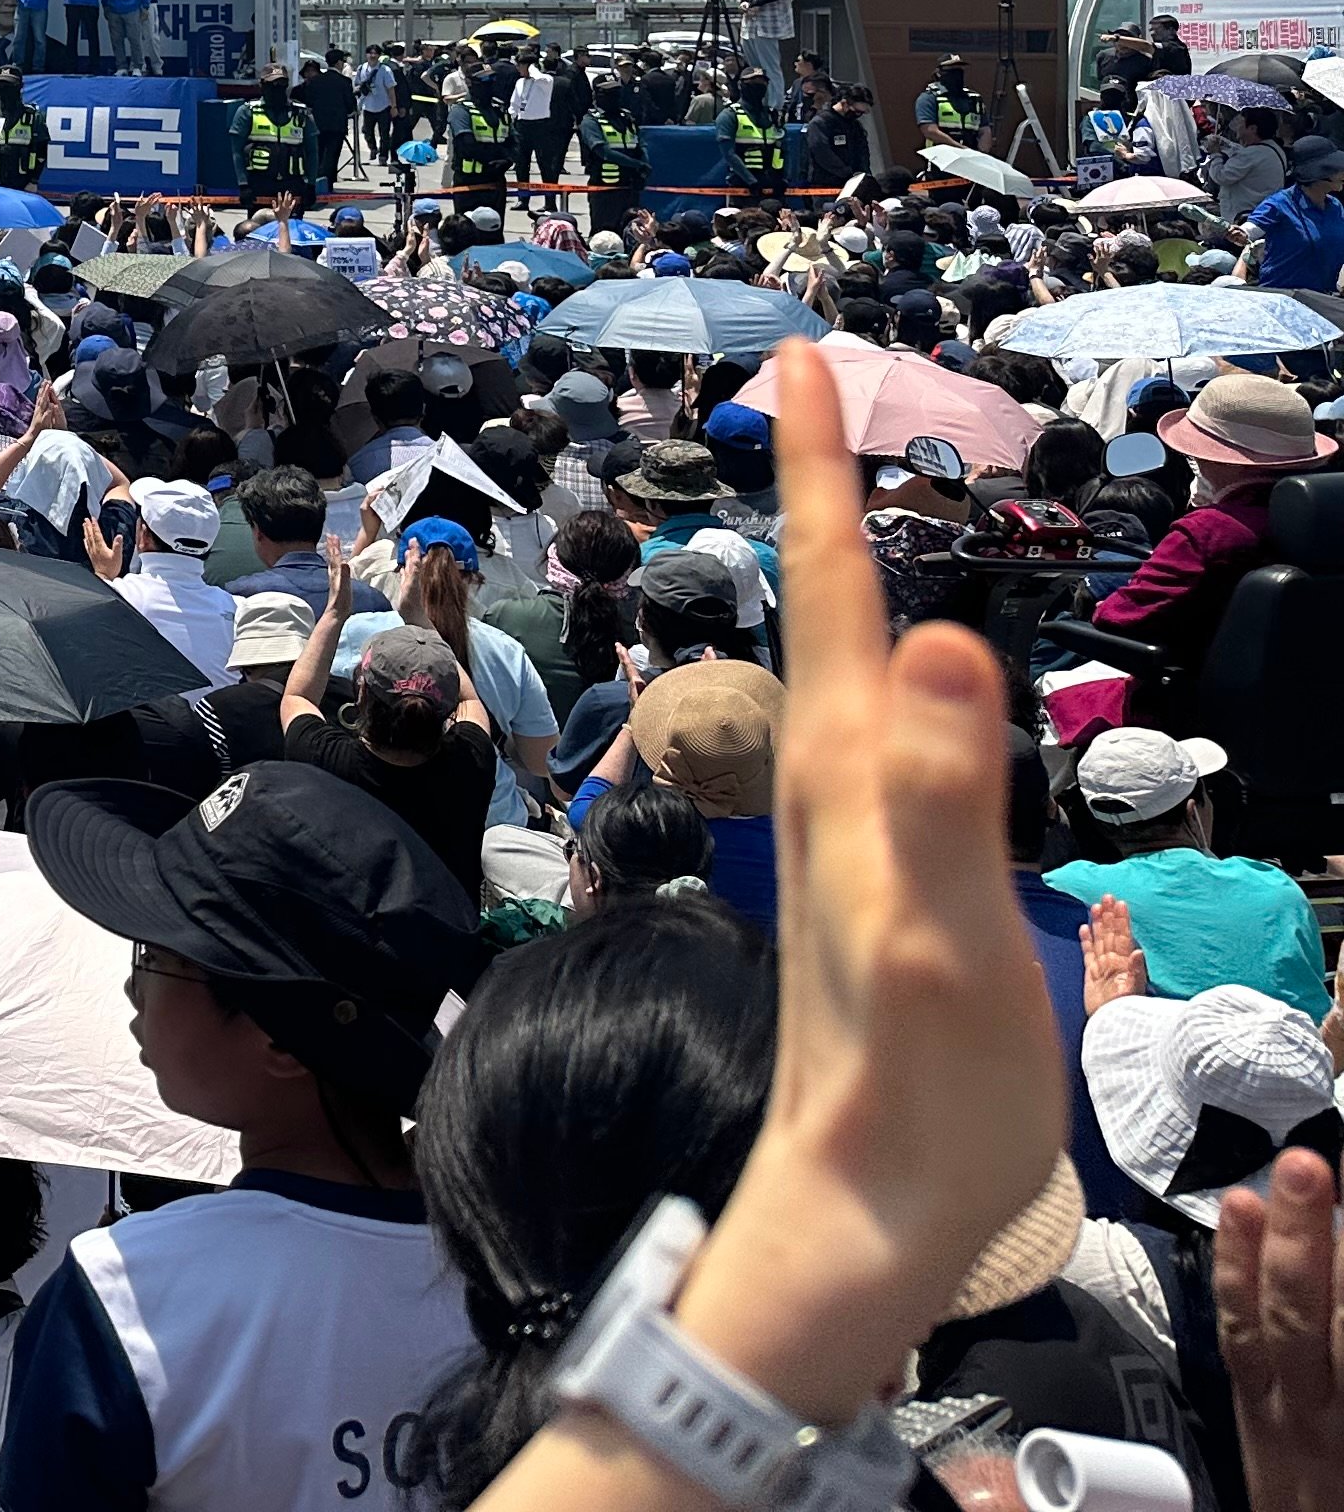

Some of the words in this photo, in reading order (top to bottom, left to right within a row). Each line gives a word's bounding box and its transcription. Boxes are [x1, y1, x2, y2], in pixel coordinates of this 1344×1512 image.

[157, 3, 233, 41] 재명
[1178, 22, 1220, 55] 북특별시,
[45, 106, 183, 176] 민국
[717, 509, 774, 528] Sunshin
